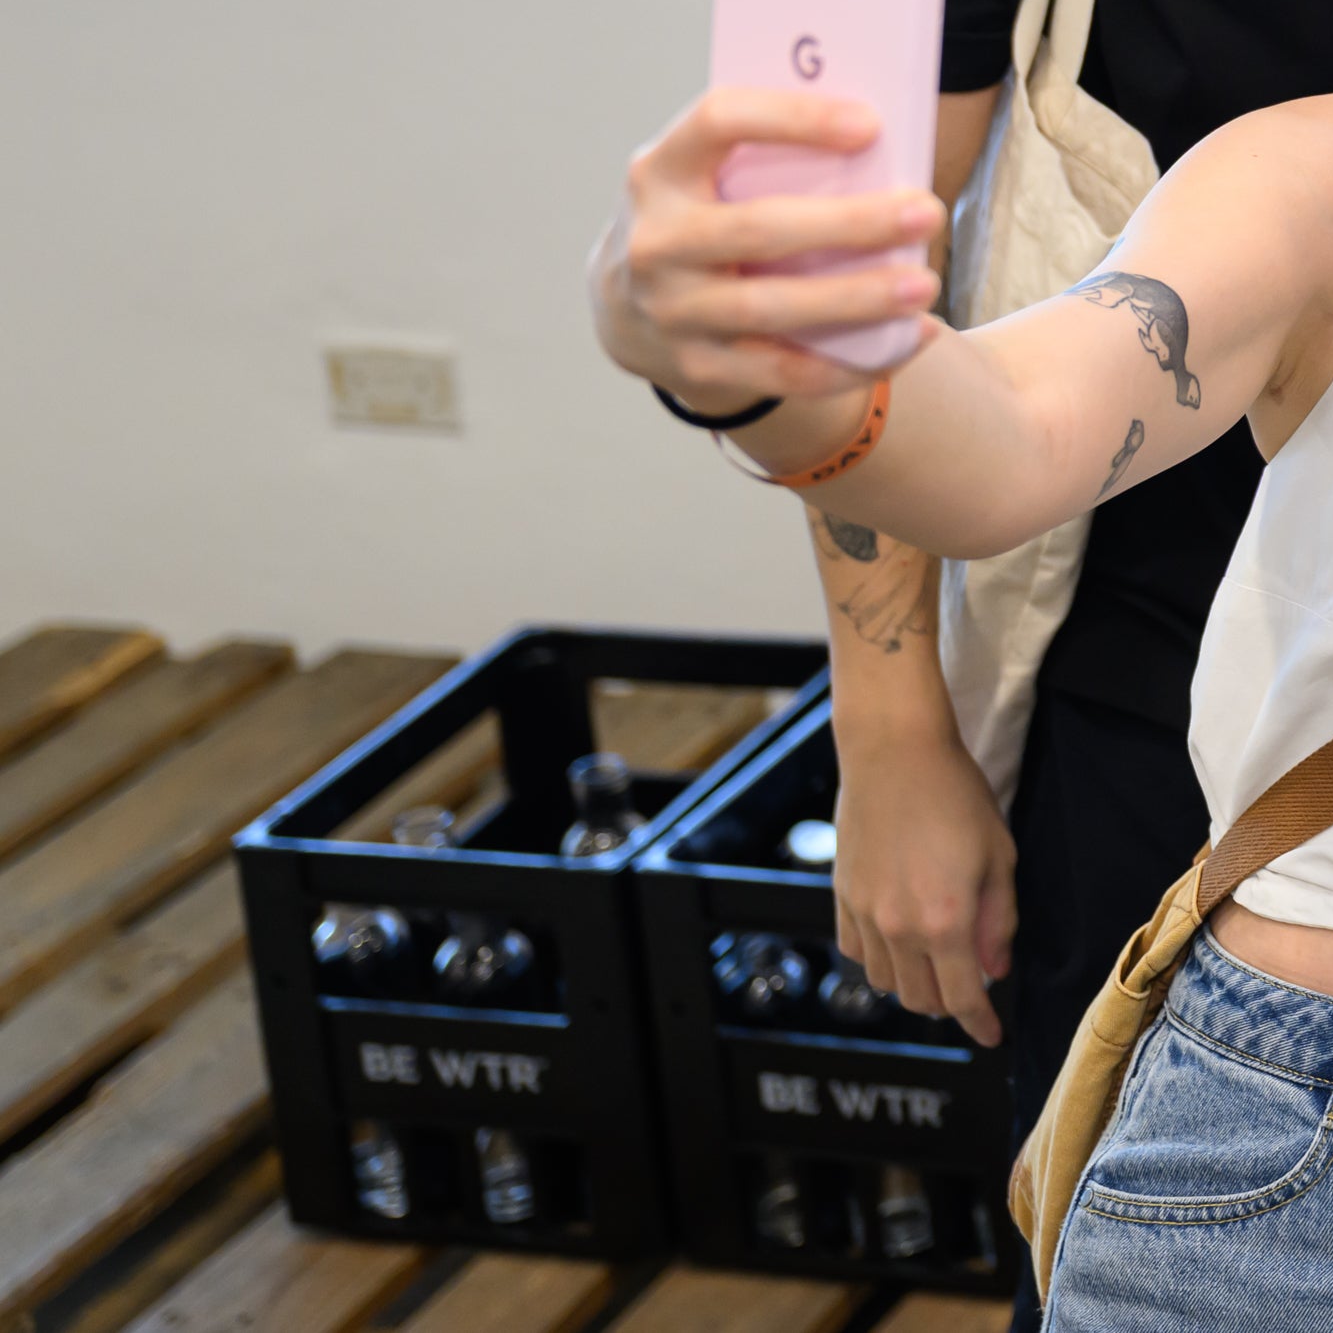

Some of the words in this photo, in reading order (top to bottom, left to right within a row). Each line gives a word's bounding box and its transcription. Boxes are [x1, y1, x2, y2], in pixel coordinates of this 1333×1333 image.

[791, 35, 825, 81] G
[360, 1040, 420, 1086] BE
[758, 1071, 820, 1116] BE
